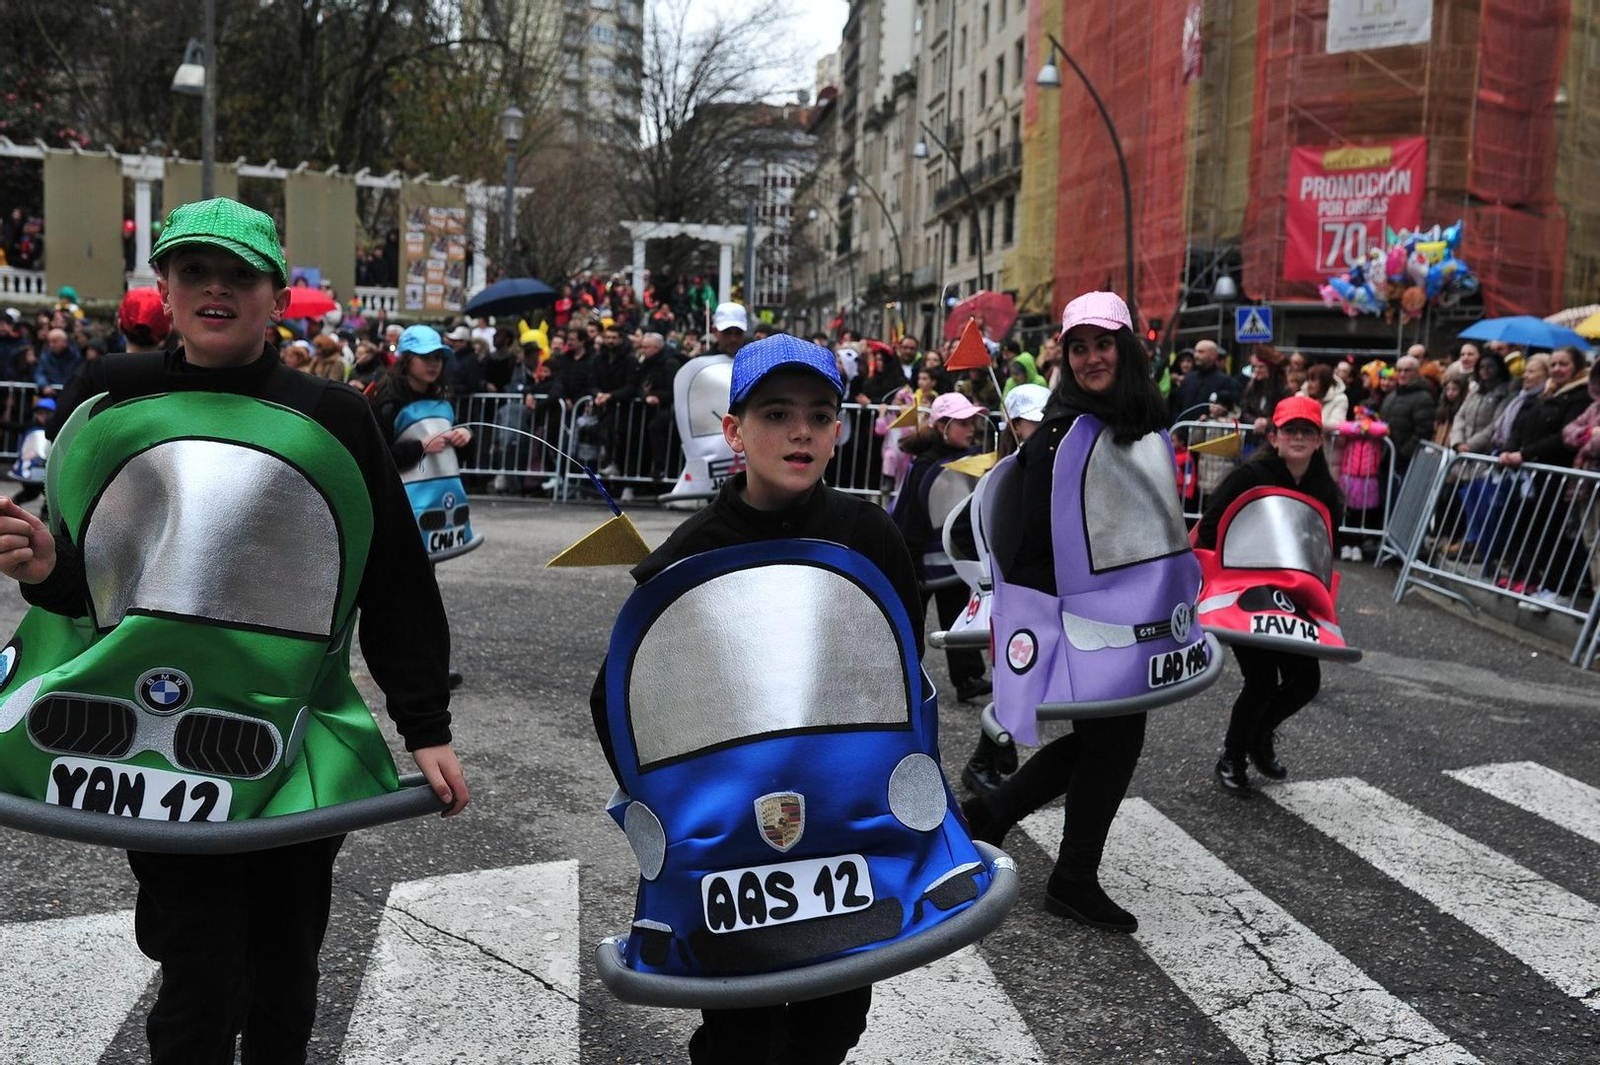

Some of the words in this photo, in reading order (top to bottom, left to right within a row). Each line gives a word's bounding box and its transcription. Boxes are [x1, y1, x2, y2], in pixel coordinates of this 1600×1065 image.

[1300, 167, 1411, 201] PROMOCIÓN
[1318, 200, 1344, 217] POR
[1323, 222, 1367, 268] 70
[1253, 615, 1297, 635] IAV
[1300, 622, 1319, 641] 14
[146, 674, 185, 686] BMW
[1151, 651, 1184, 686] LAD
[52, 764, 145, 818] YAN
[160, 780, 220, 822] 12
[707, 871, 799, 930] AAS
[813, 861, 870, 912] 12
